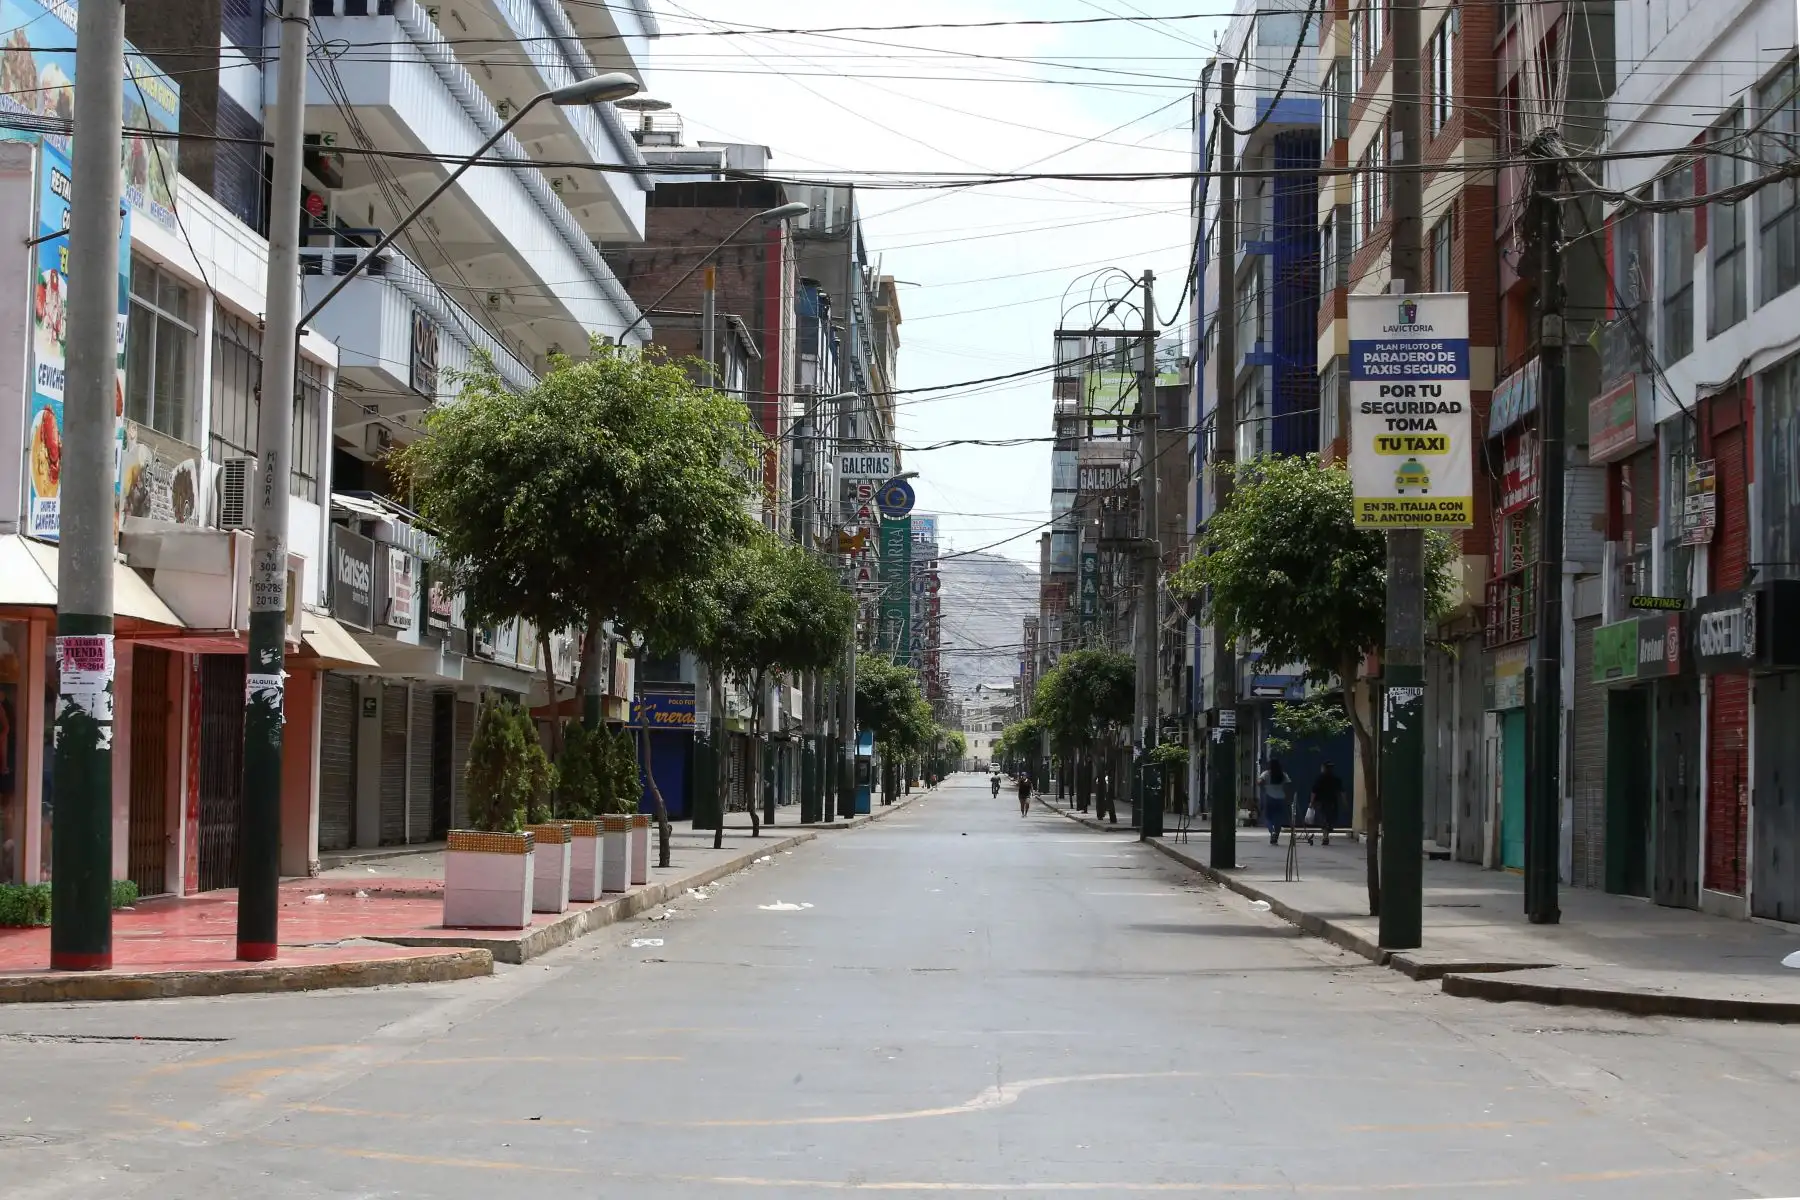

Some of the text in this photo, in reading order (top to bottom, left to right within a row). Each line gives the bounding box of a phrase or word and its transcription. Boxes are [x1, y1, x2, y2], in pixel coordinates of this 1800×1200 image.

[1363, 352, 1455, 363] PARADERO DE
[1363, 364, 1457, 375] TAXIS SEGURO
[1380, 385, 1442, 397] POR TU
[1360, 401, 1462, 414] SEGURIDAD
[1385, 418, 1437, 431] TOMA
[1379, 438, 1445, 450] TU TAXI
[841, 457, 889, 474] GALERIAS
[1080, 468, 1128, 490] GALERIAS
[1363, 502, 1463, 512] EN JR. ITALIA CON
[1361, 513, 1466, 523] JR. ANTONIO BAZO
[338, 547, 369, 593] Kansas
[256, 596, 279, 605] 2018
[1632, 596, 1682, 608] CORTINAS
[64, 647, 103, 657] TIENDA
